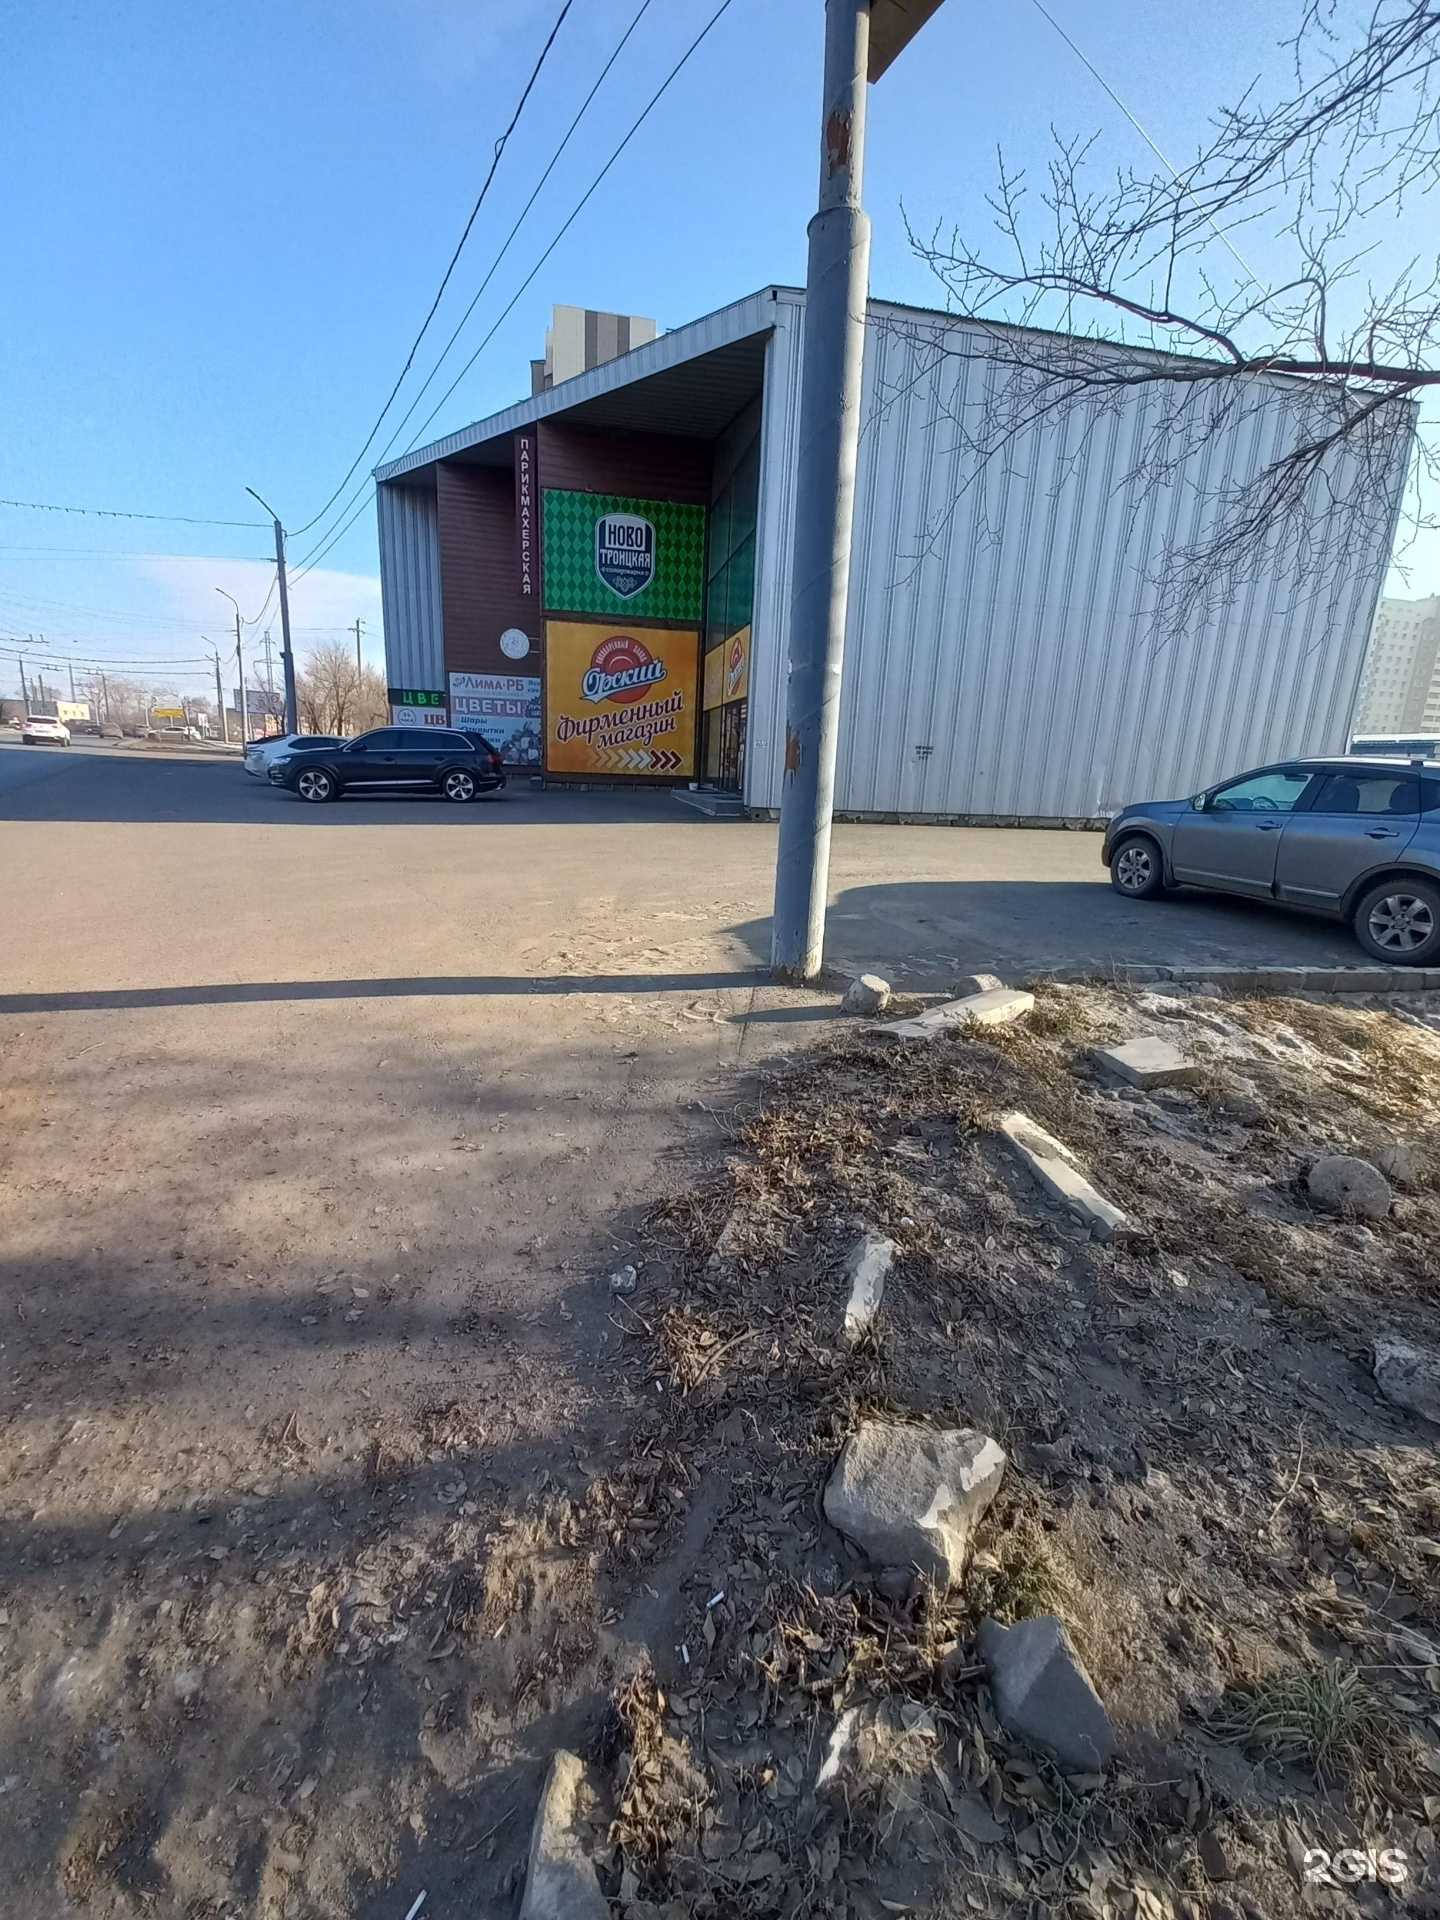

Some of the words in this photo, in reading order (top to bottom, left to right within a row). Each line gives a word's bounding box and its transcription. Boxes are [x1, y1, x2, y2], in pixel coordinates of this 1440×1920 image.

[520, 439, 531, 594] ПАРИКМАХЕРСКАЯ
[608, 524, 644, 548] НОВО
[600, 549, 650, 568] ТРОИЦКАЯ
[582, 658, 666, 700] Орский
[403, 691, 447, 705] ЦВЕ
[455, 698, 521, 714] ЦВЕТЫ
[460, 716, 487, 725] Шары
[557, 690, 683, 743] Фирменный
[597, 717, 675, 748] магазин
